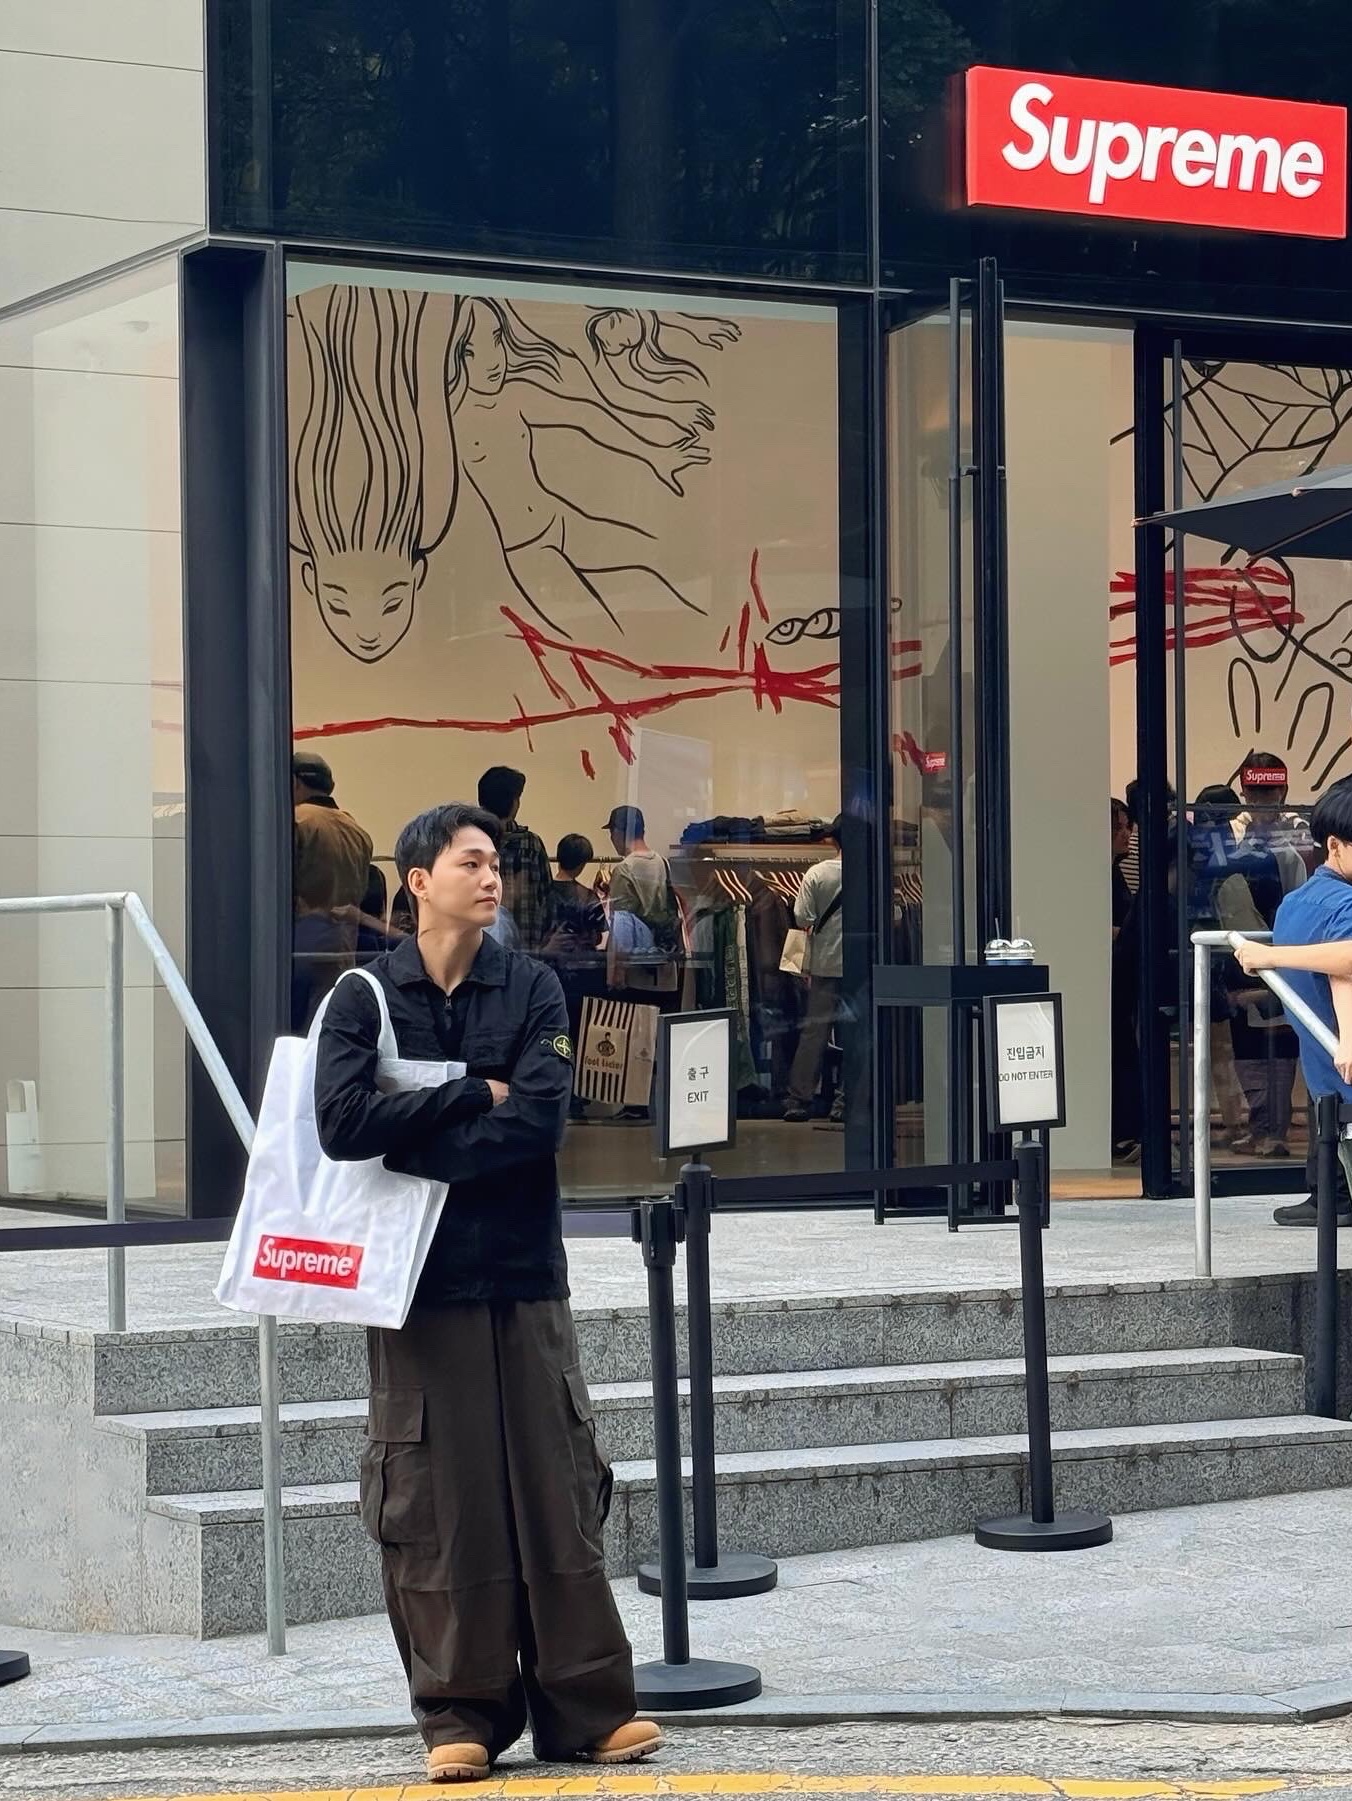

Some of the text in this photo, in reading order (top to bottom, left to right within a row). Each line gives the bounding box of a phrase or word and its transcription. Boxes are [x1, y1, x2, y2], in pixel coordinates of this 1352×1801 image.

[1002, 83, 1324, 204] Supreme
[1006, 1045, 1045, 1060] 진입금지
[1012, 1071, 1027, 1080] NOT
[1028, 1070, 1053, 1080] ENTER
[687, 1090, 709, 1103] EXIT
[259, 1238, 354, 1278] Supreme
